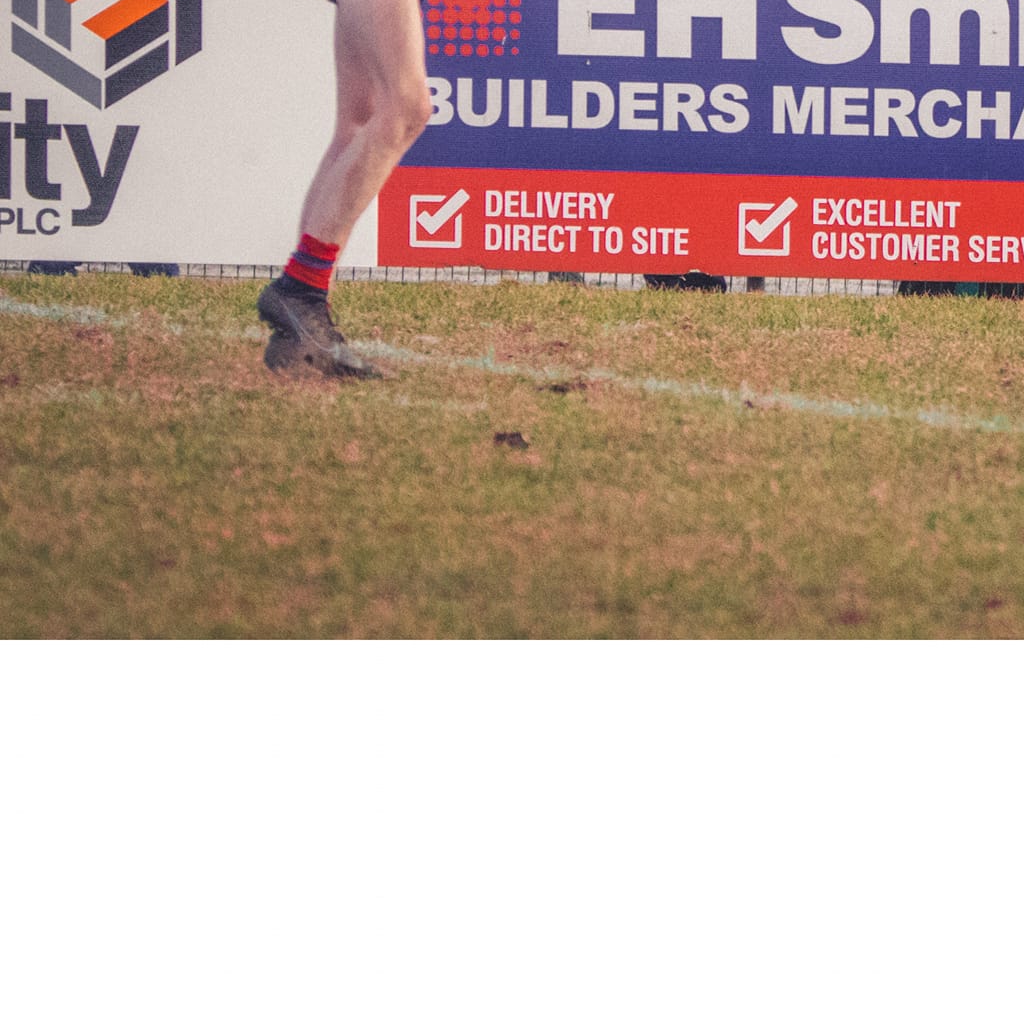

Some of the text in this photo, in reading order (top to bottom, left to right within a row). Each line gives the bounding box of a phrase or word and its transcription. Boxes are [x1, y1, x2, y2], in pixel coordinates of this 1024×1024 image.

[426, 78, 750, 133] BUILDERS
[485, 190, 614, 219] DELIVERY
[812, 198, 960, 228] EXCELLENT
[0, 207, 61, 235] PLC
[485, 224, 689, 255] DIRECT TO SITE
[812, 232, 959, 262] CUSTOMER
